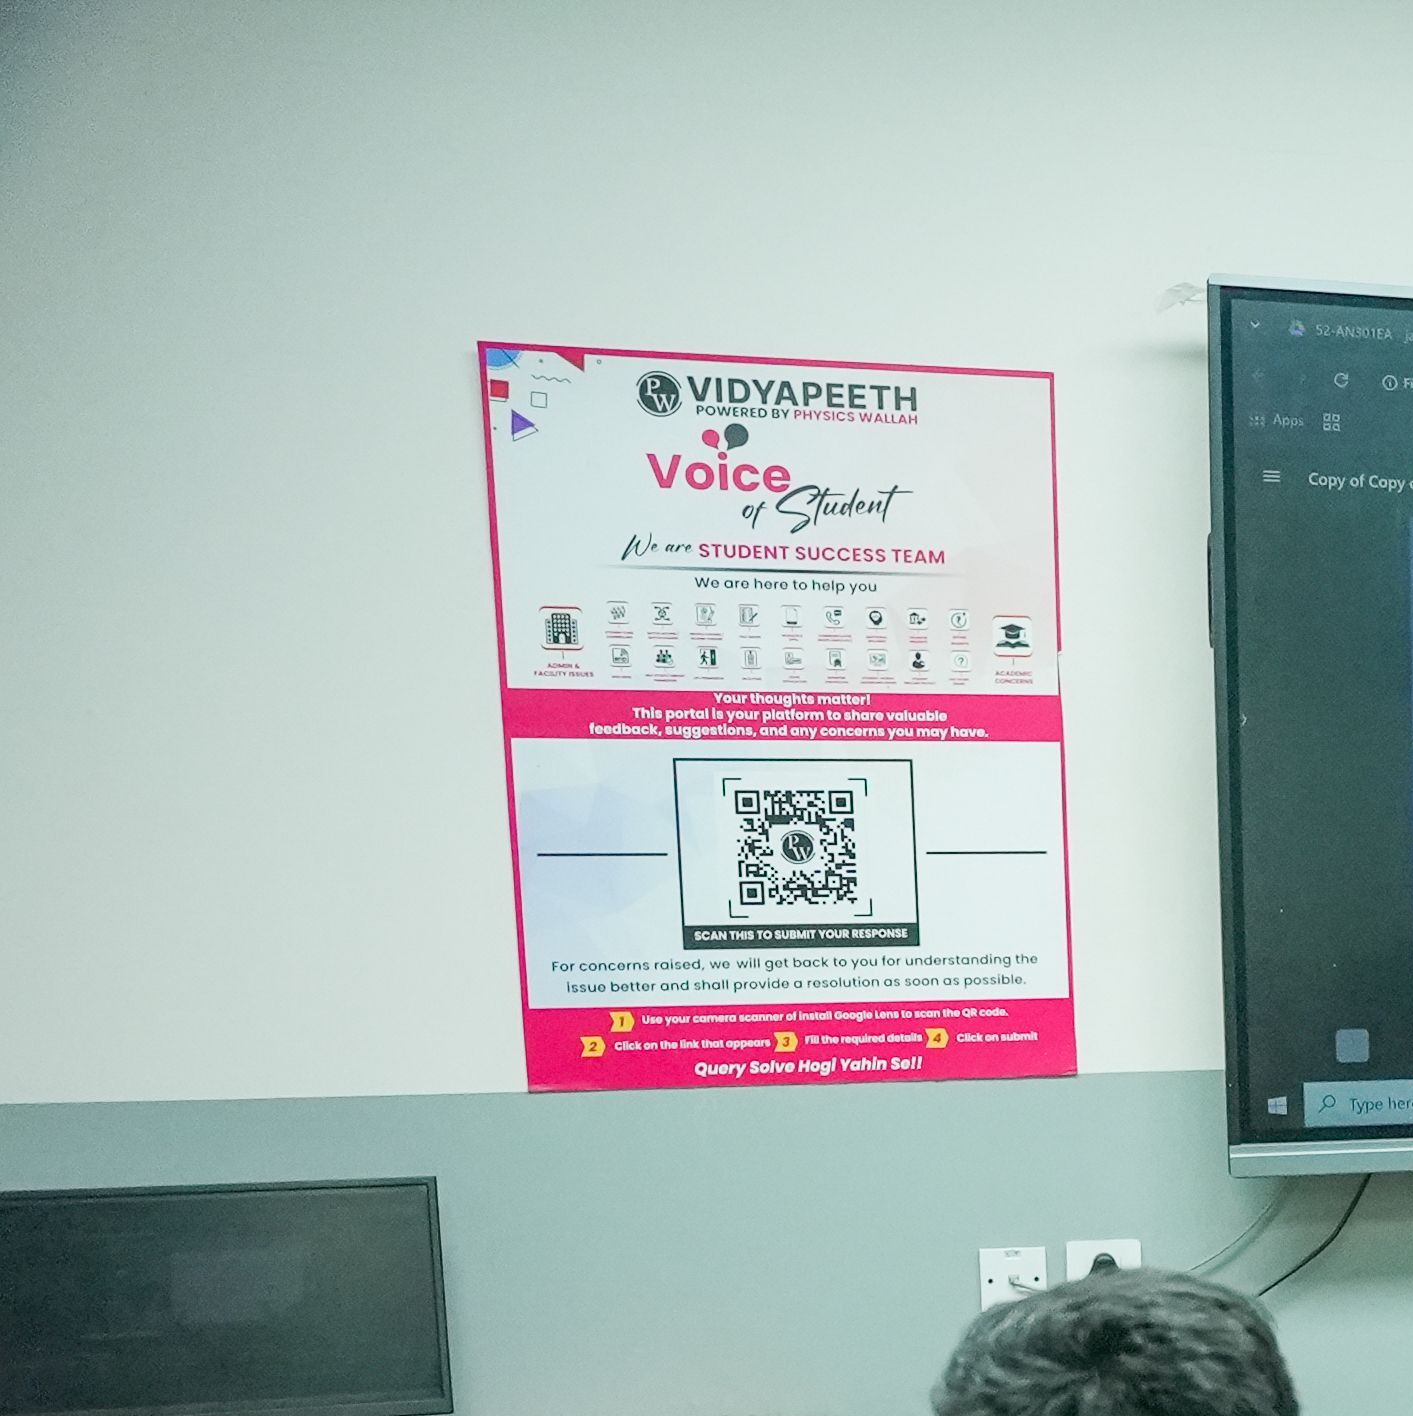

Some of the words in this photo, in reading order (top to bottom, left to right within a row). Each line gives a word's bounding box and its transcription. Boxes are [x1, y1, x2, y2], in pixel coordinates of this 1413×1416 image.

[686, 375, 918, 411] VIDYAPEETH
[695, 404, 768, 419] POWERED
[770, 407, 790, 419] BY
[793, 409, 855, 422] PHYSICS
[858, 412, 918, 424] WALLAH
[1272, 413, 1304, 429] Apps
[646, 451, 791, 493] Voice
[1307, 471, 1346, 491] Copy
[1348, 473, 1365, 488] of
[1367, 474, 1406, 493] Copy
[742, 501, 767, 529] of
[775, 484, 914, 534] Student
[621, 532, 658, 561] We
[664, 541, 693, 555] are
[698, 543, 790, 560] STUDENT
[795, 545, 886, 563] SUCCESS
[891, 548, 945, 564] TEAM
[693, 576, 720, 589] We
[723, 579, 750, 589] are
[753, 577, 789, 590] here
[792, 579, 808, 591] to
[811, 579, 845, 595] help
[848, 582, 877, 595] you
[714, 692, 747, 704] Your
[749, 692, 815, 707] thoughts
[817, 693, 871, 705] matter!
[632, 707, 662, 719] This
[665, 707, 709, 722] portal
[711, 707, 723, 719] is
[727, 709, 760, 723] your
[762, 708, 825, 723] platform
[826, 710, 842, 721] to
[843, 709, 885, 721] share
[886, 709, 948, 722] valuable
[588, 722, 662, 736] feedback,
[664, 723, 757, 739] suggestions,
[758, 724, 788, 737] and
[789, 726, 818, 740] any
[819, 726, 886, 737] concerns
[886, 727, 914, 740] you
[915, 727, 949, 741] may
[949, 725, 989, 738] have.
[693, 930, 727, 941] SCAN
[728, 929, 755, 941] THIS
[756, 929, 773, 940] TO
[773, 928, 817, 940] SUBMIT
[817, 928, 850, 939] YOUR
[851, 927, 908, 939] RESPONSE
[551, 960, 576, 973] For
[578, 961, 650, 972] concerns
[653, 958, 705, 971] raised,
[709, 960, 731, 970] we
[735, 957, 761, 969] will
[764, 957, 789, 973] get
[792, 956, 829, 968] back
[832, 956, 848, 968] to
[850, 957, 878, 970] you
[881, 954, 901, 967] for
[904, 953, 1011, 968] understanding
[1014, 953, 1038, 964] the
[566, 981, 607, 993] issue
[609, 980, 656, 993] better
[659, 979, 690, 992] and
[693, 978, 729, 991] shall
[733, 977, 790, 993] provide
[793, 979, 803, 989] a
[806, 976, 880, 989] resolution
[883, 977, 901, 987] as
[904, 977, 939, 987] soon
[942, 976, 960, 986] as
[963, 973, 1026, 989] possible.
[694, 1061, 747, 1078] Query
[749, 1059, 796, 1074] Solve
[797, 1056, 837, 1076] Hogi
[839, 1055, 888, 1072] Yahin
[1349, 1097, 1384, 1115] Type
